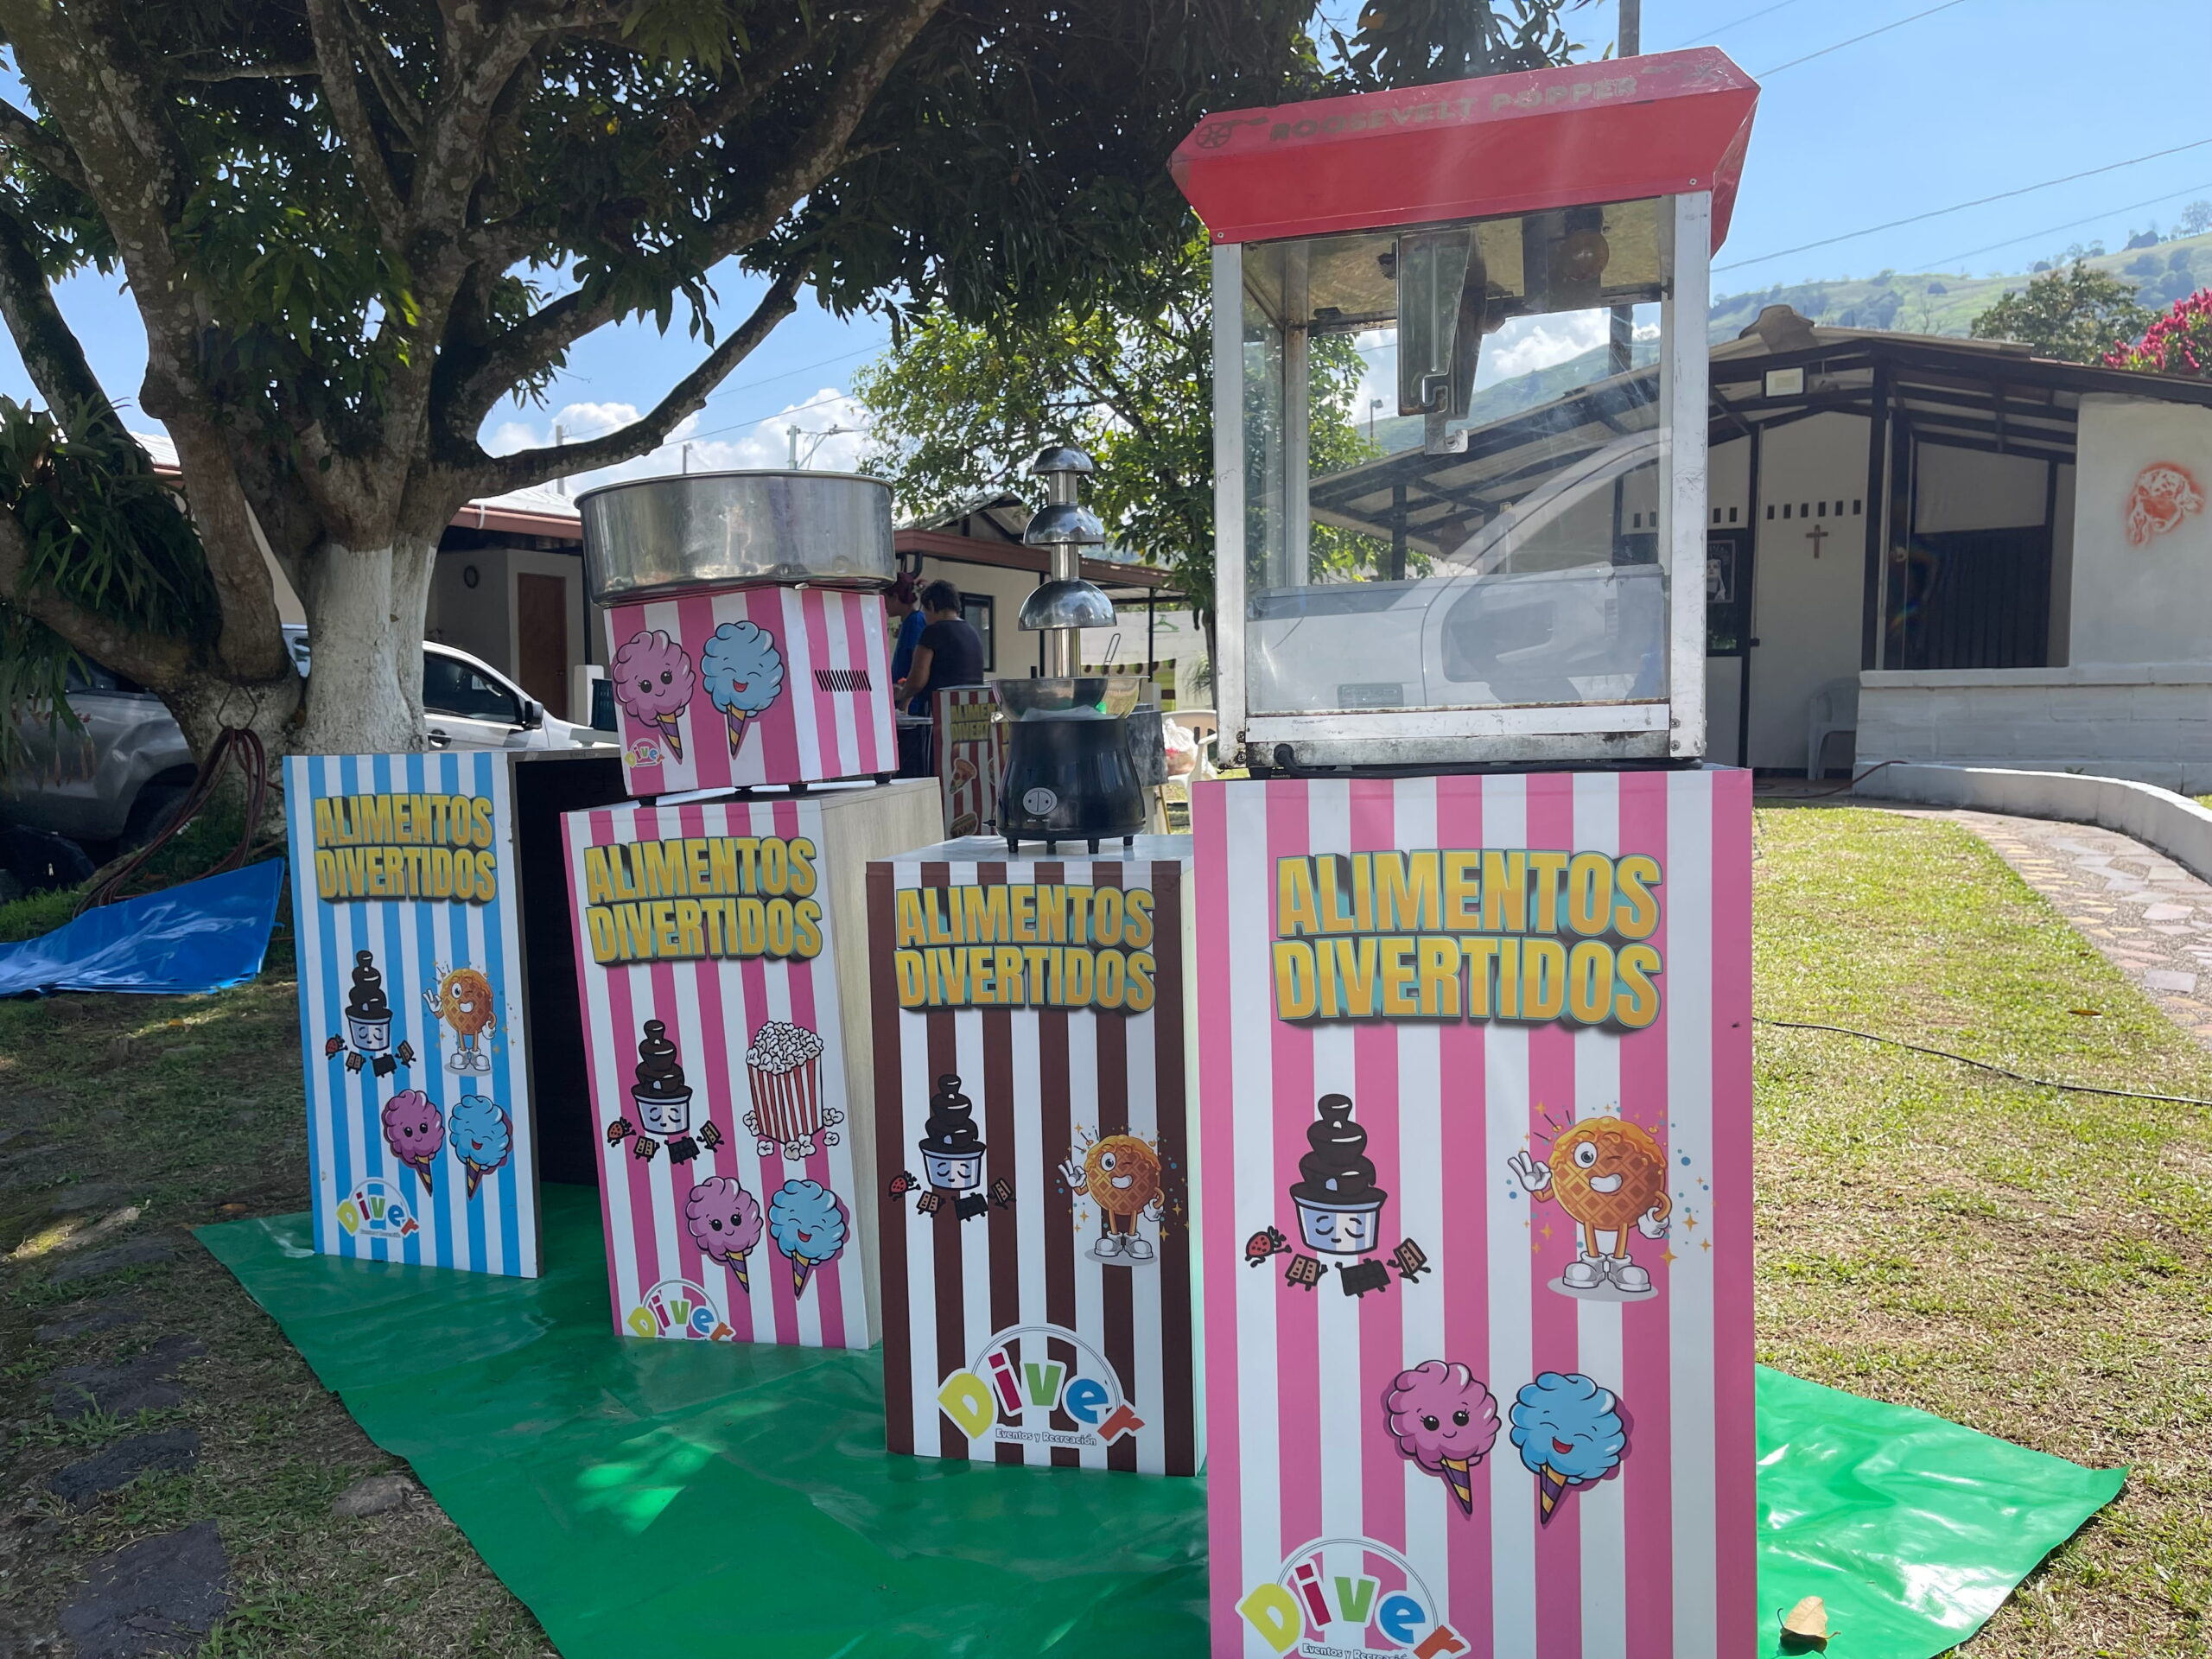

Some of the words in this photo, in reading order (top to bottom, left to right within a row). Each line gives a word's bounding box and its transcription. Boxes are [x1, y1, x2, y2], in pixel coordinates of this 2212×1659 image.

[1269, 98, 1478, 141] ROOSEVELT
[1491, 77, 1638, 112] POPPER
[625, 747, 664, 767] Diver
[950, 721, 991, 741] DIVERT
[315, 793, 493, 849] ALIMENTOS
[315, 846, 497, 902] DIVERTIDOS
[584, 836, 817, 906] ALIMENTOS
[1277, 849, 1662, 940] ALIMENTOS
[585, 897, 823, 963] DIVERTIDOS
[896, 883, 1155, 950] ALIMENTOS
[893, 946, 1157, 1013] DIVERTIDOS
[1271, 936, 1663, 1029] DIVERTIDOS
[336, 1192, 419, 1236] Diver
[627, 1295, 734, 1341] Diver
[938, 1351, 1146, 1441] Diver
[995, 1428, 1033, 1440] Eventos
[1033, 1433, 1041, 1443] y
[1042, 1431, 1097, 1446] Recreación
[1240, 1563, 1466, 1659] Diver
[1302, 1643, 1343, 1657] Eventos
